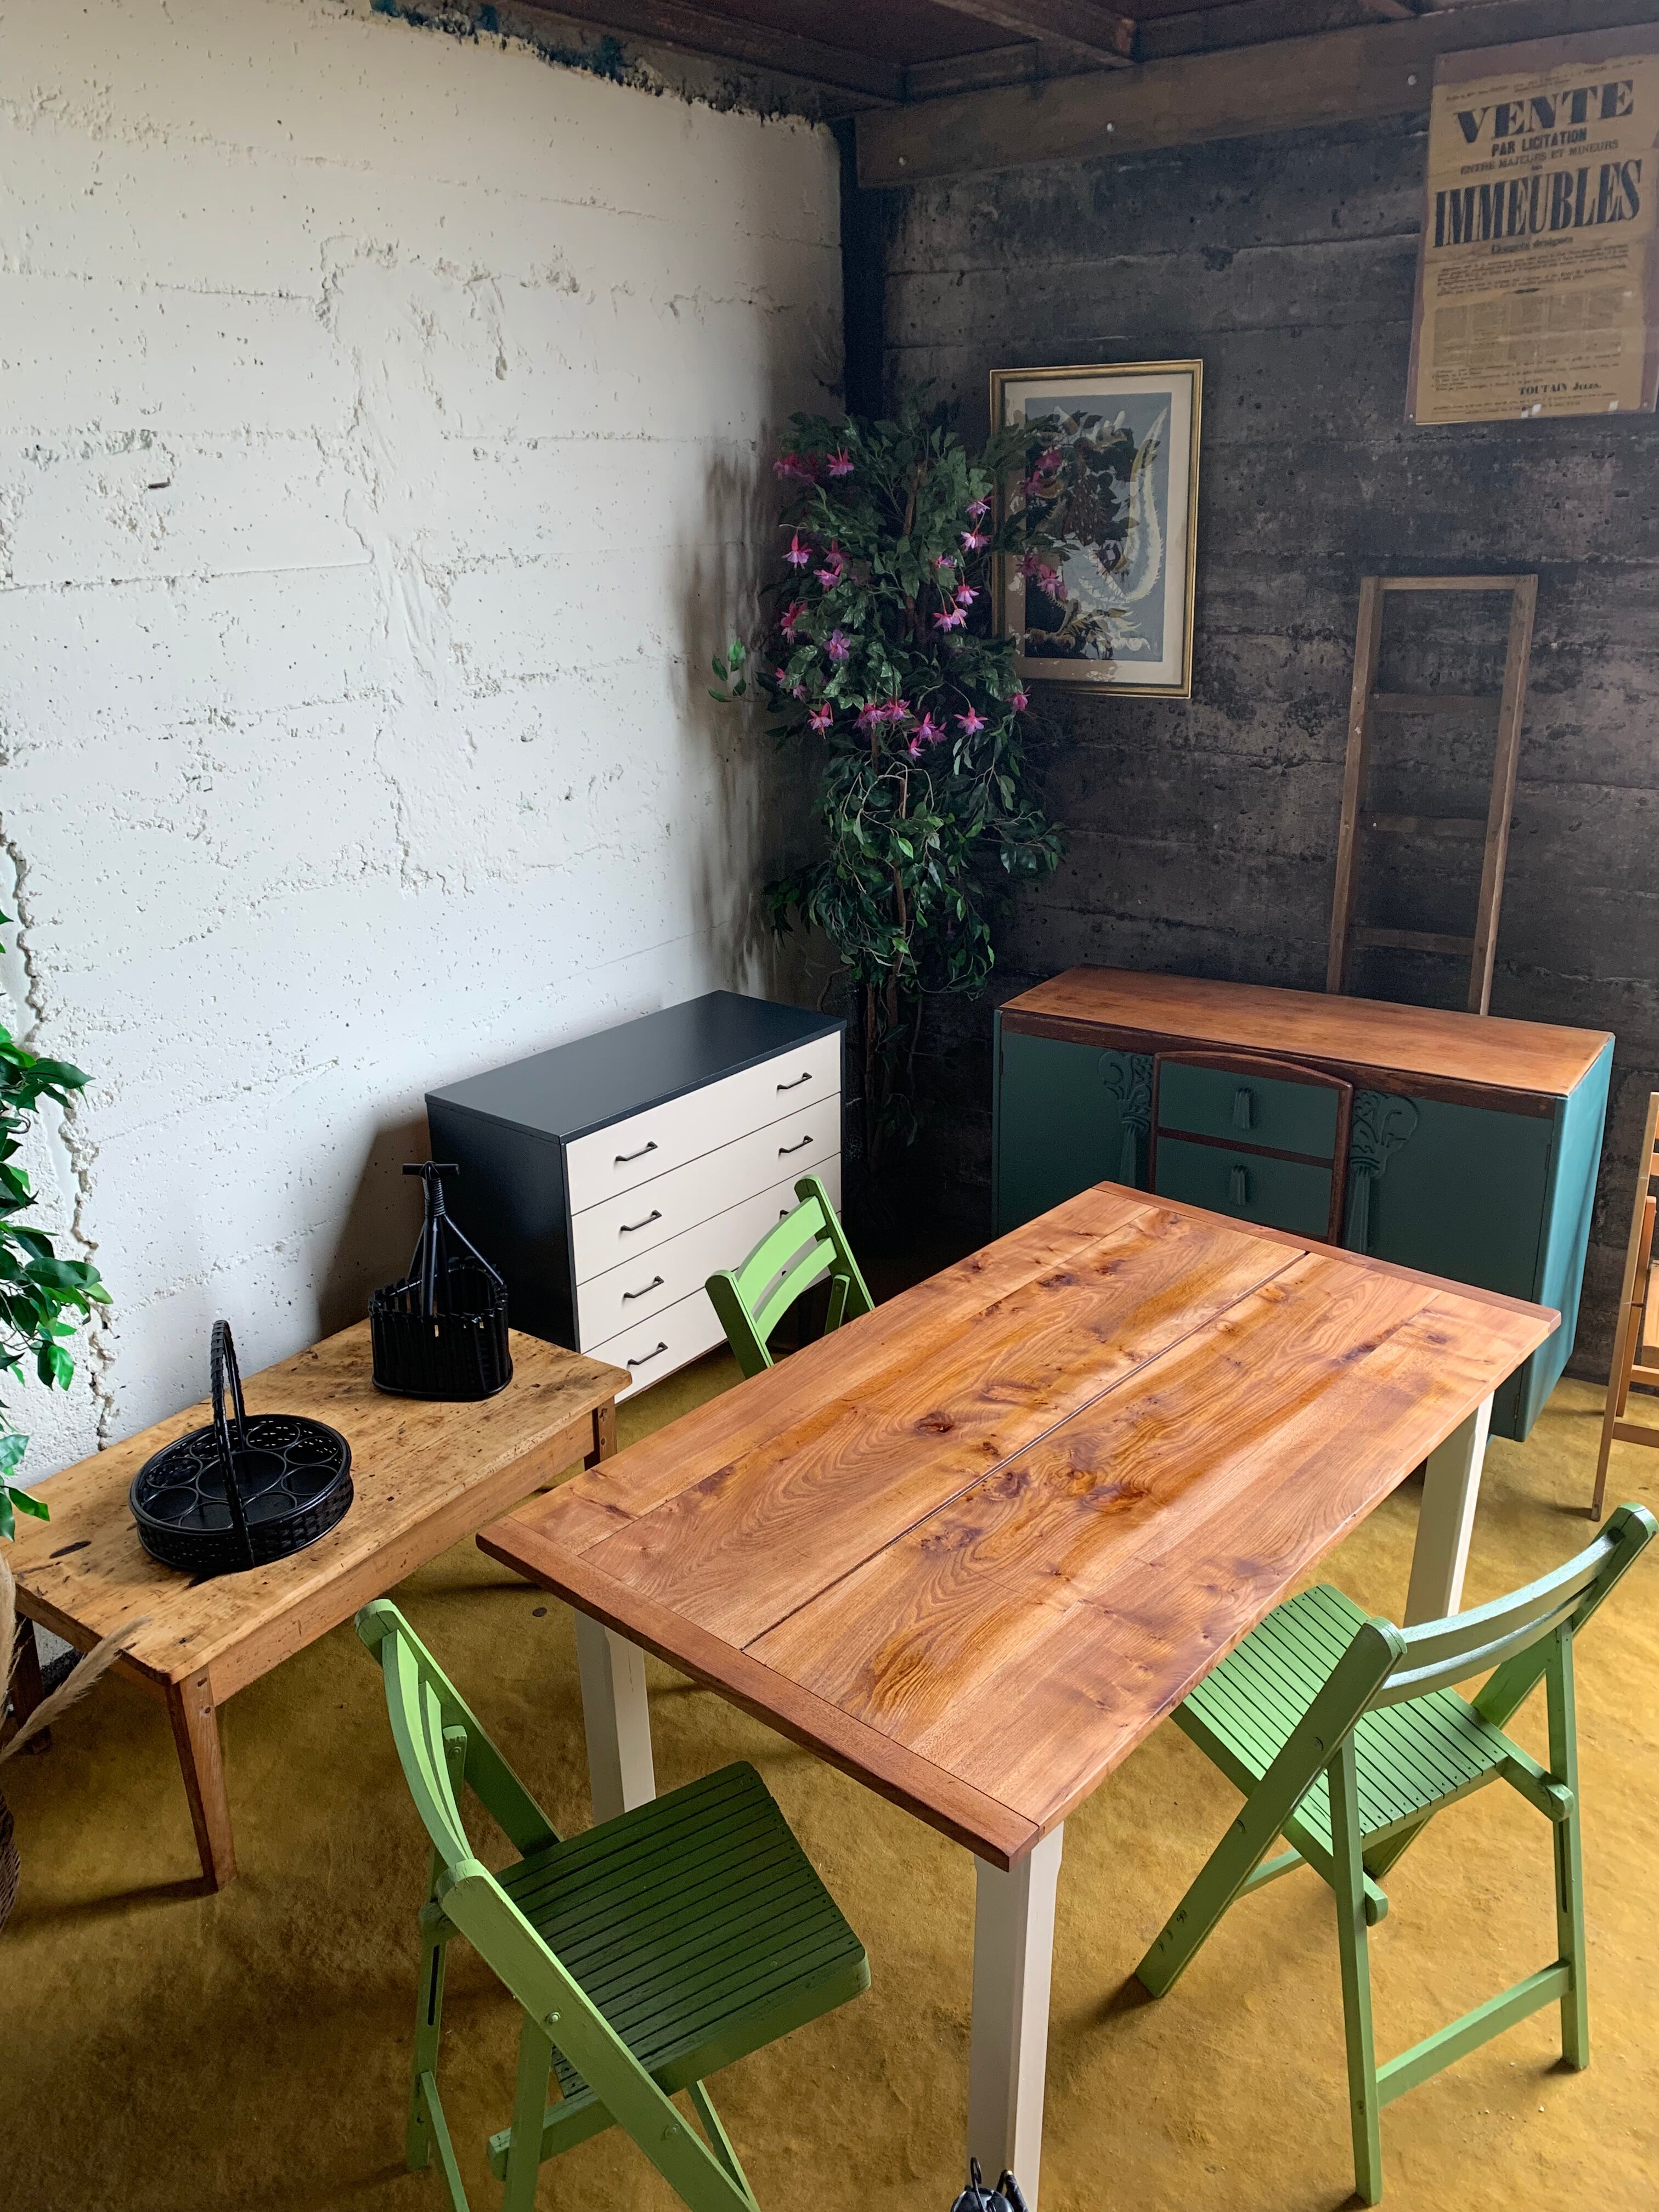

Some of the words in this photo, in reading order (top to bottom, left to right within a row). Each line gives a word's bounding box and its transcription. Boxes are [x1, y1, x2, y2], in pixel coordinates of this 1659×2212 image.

[1453, 80, 1634, 144] VENTE
[1492, 141, 1515, 157] PAR
[1522, 127, 1588, 152] LICITATION
[1569, 139, 1618, 156] MINEURS
[1433, 159, 1642, 248] IMMEUBLES
